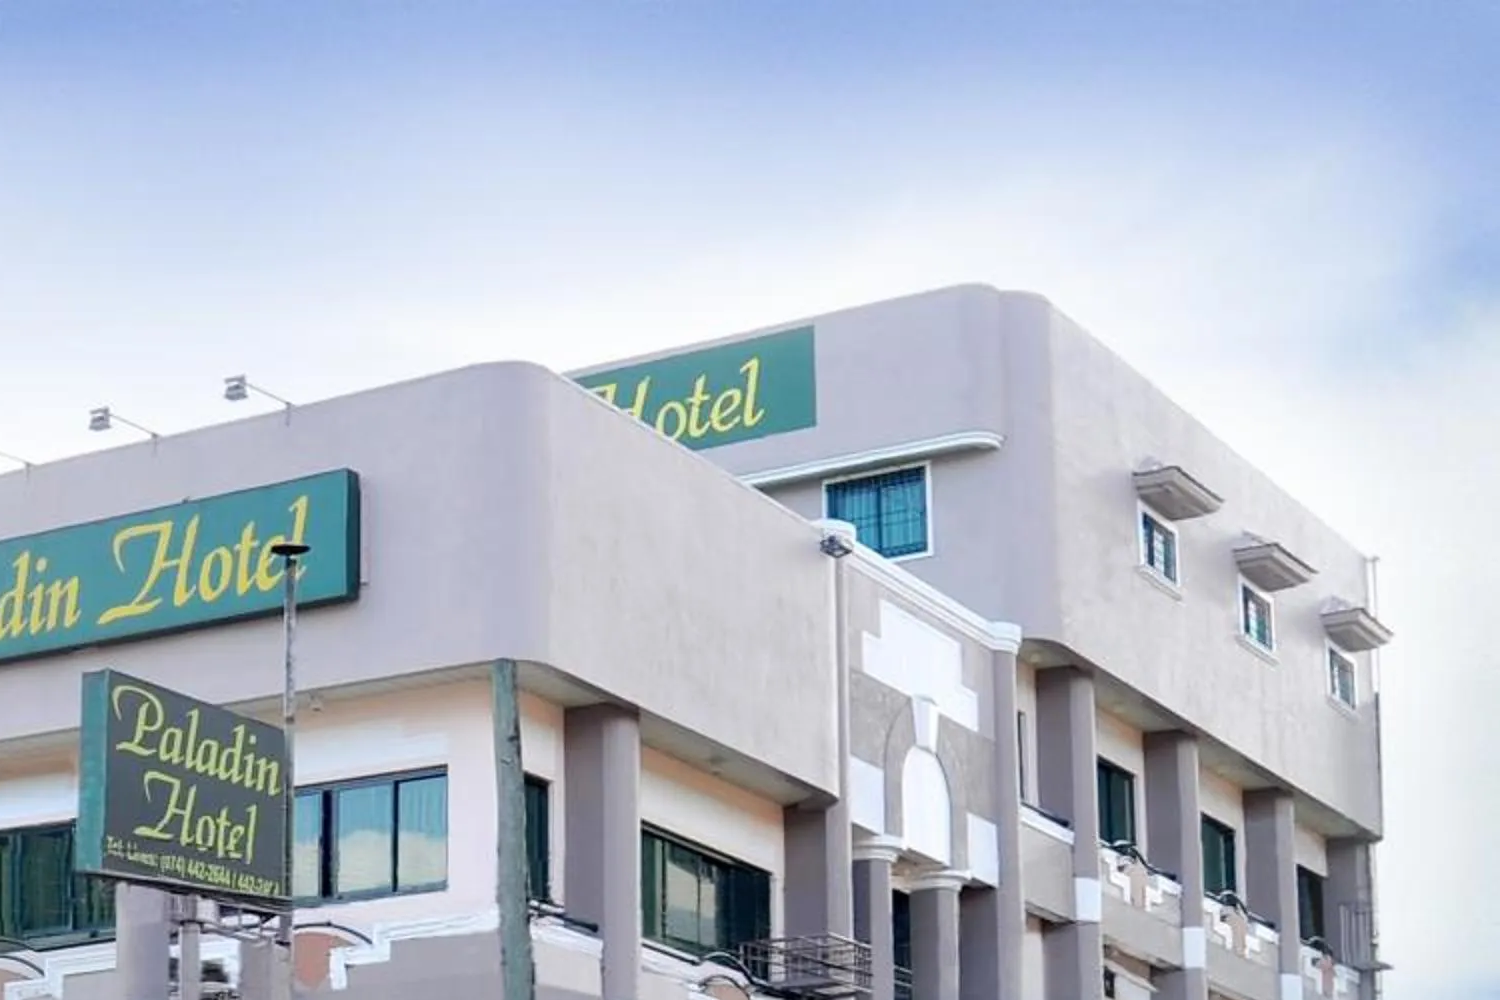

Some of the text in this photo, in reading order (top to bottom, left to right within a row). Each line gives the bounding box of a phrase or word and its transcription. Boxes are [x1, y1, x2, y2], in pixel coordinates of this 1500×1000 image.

[97, 495, 308, 625] Hotel
[112, 684, 282, 796] Paladin
[132, 770, 258, 865] Hotel
